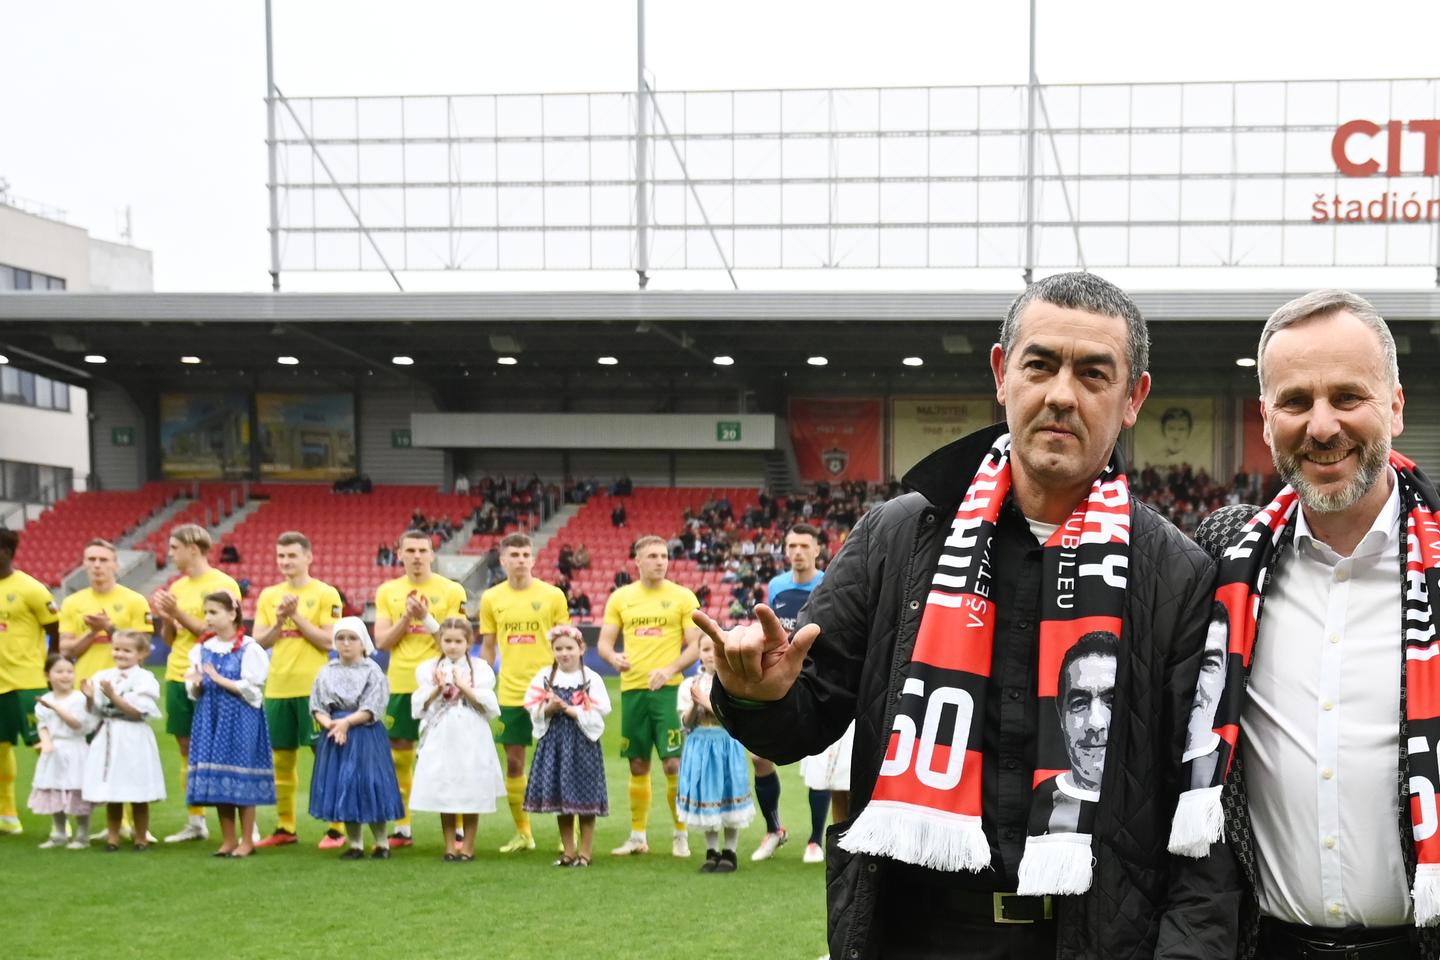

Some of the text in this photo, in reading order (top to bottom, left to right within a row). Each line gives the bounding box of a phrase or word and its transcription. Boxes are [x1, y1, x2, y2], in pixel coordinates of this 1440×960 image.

[723, 429, 737, 440] 20
[504, 620, 540, 632] PRETO
[631, 616, 667, 627] PRETO
